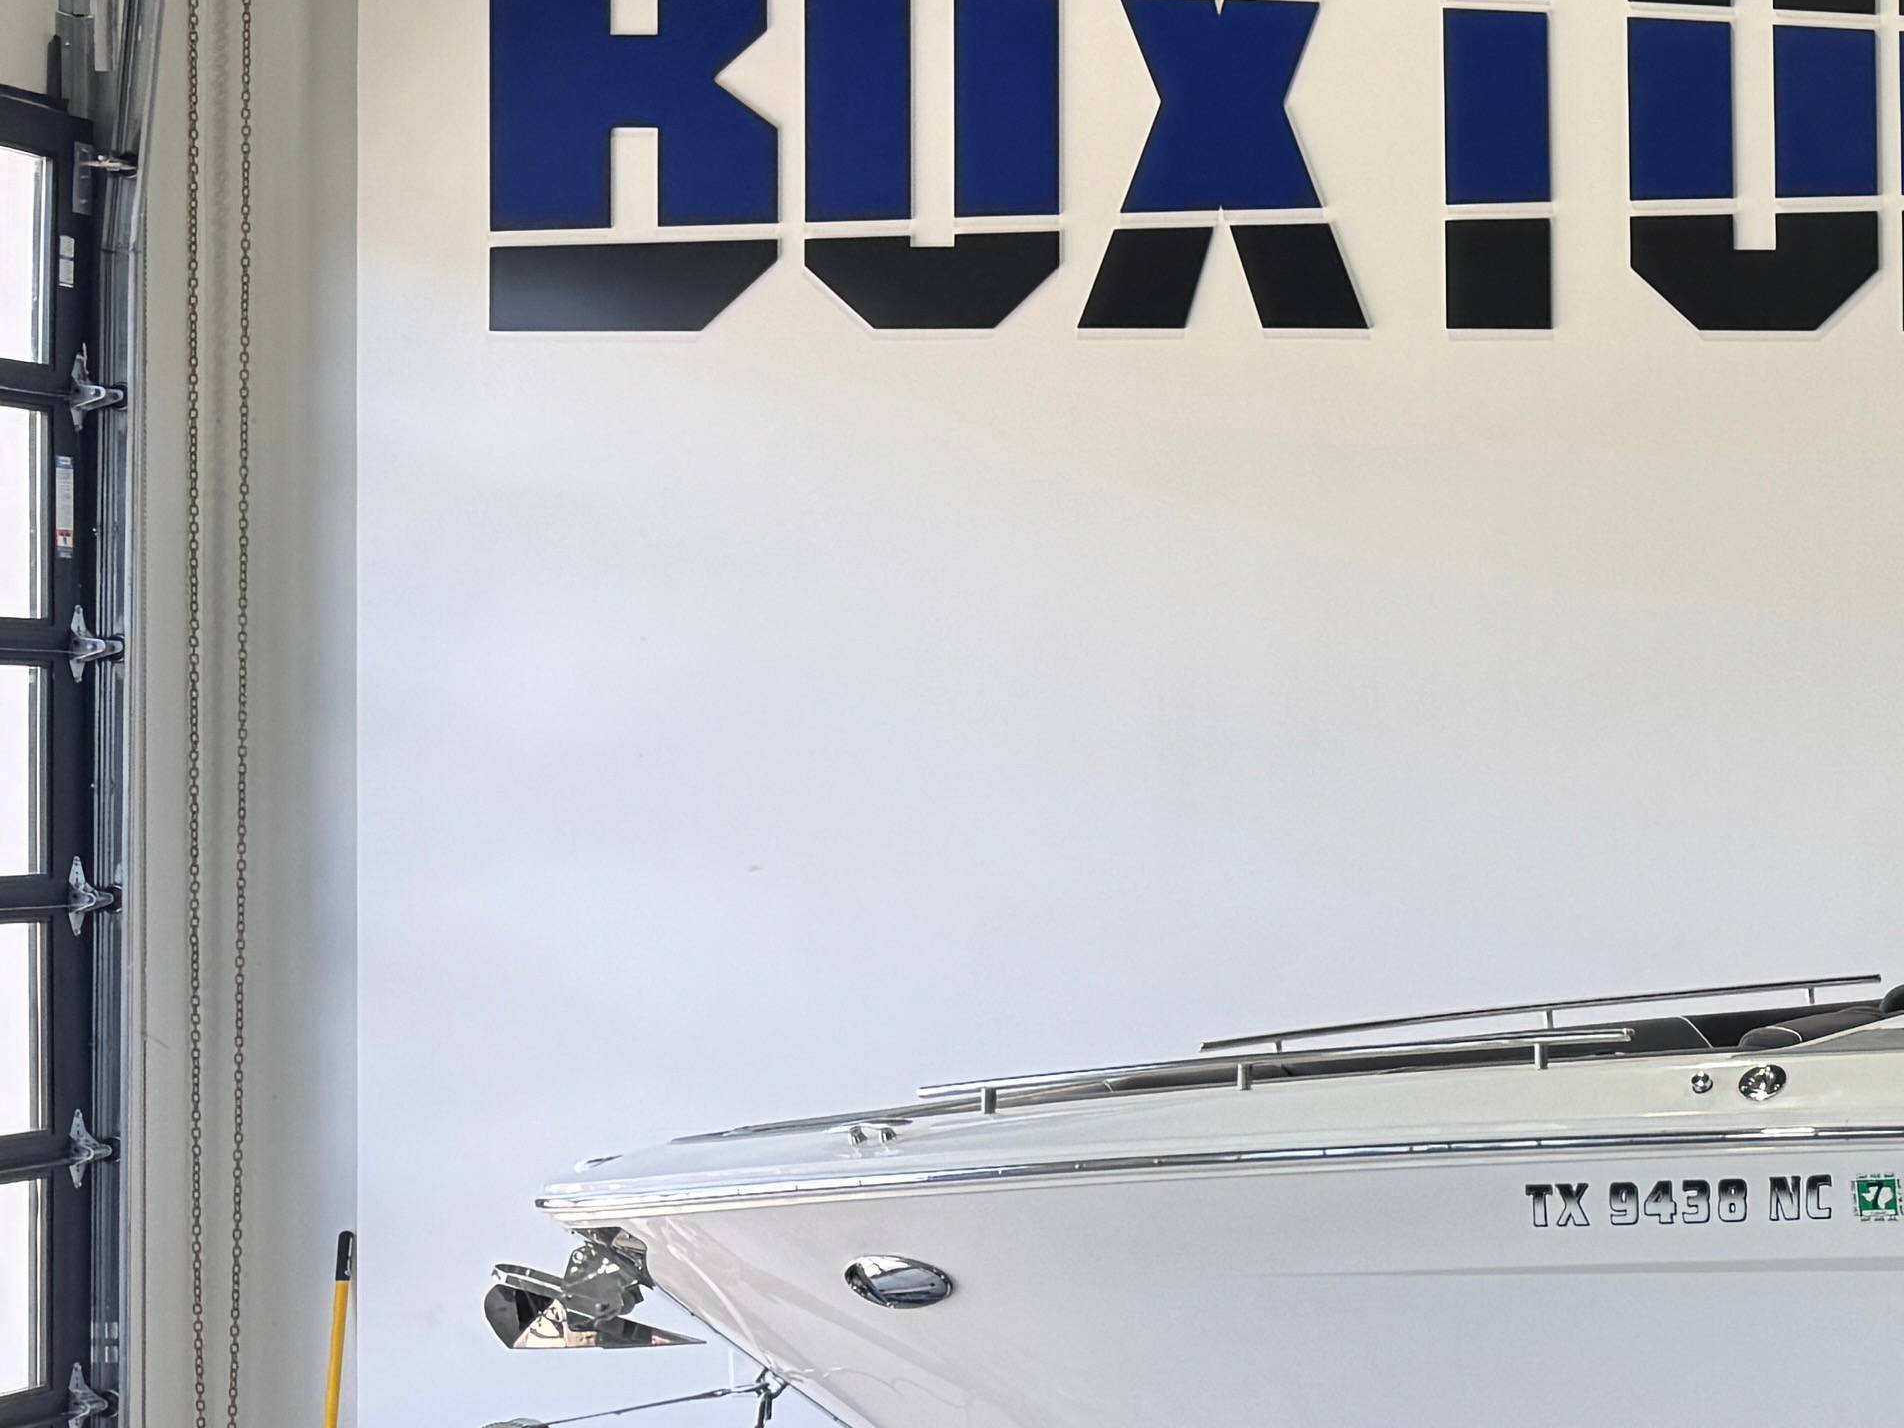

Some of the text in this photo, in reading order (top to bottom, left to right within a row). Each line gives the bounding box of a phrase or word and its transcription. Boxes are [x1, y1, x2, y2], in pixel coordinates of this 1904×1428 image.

[1525, 1174, 1833, 1228] TX 9438 NC
